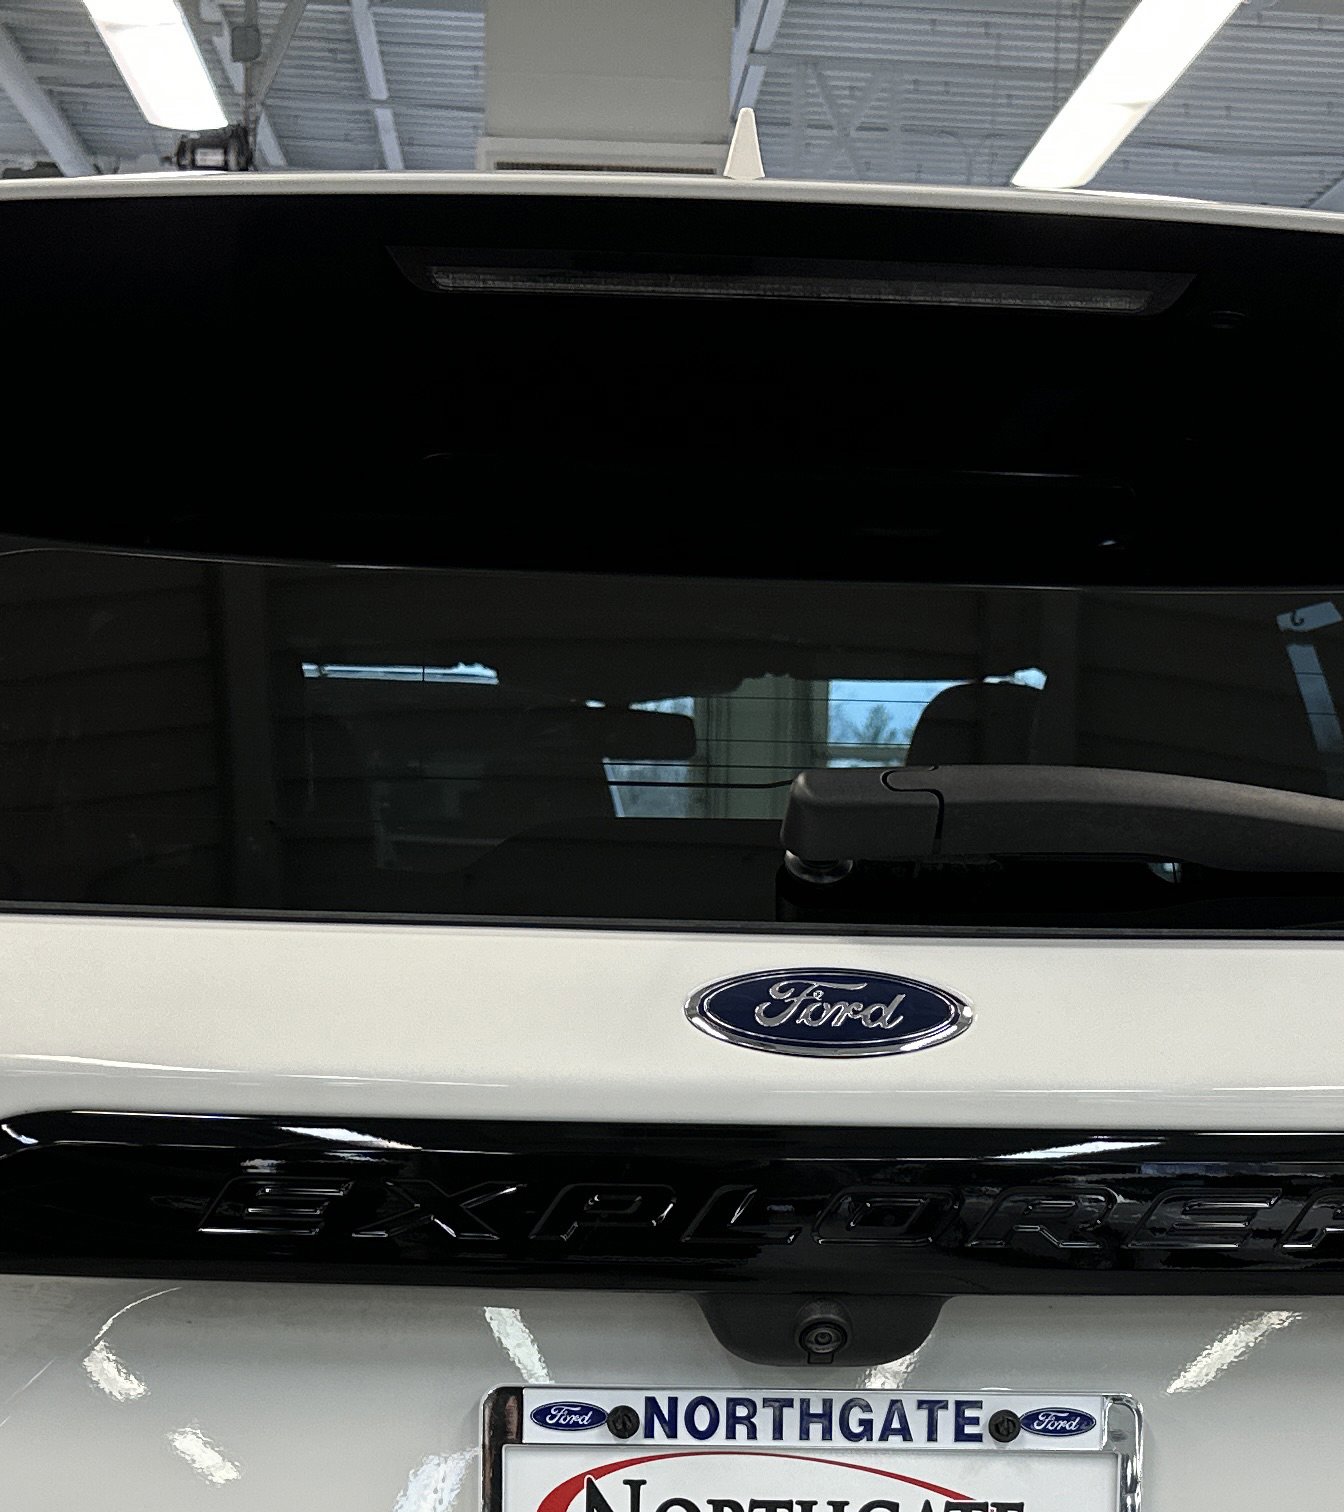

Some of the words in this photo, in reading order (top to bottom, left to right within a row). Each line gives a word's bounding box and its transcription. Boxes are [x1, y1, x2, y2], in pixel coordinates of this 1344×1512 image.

[755, 980, 906, 1029] Ford
[545, 1404, 592, 1426] Ford
[643, 1396, 983, 1442] NORTHGATE
[1033, 1411, 1080, 1431] Ford
